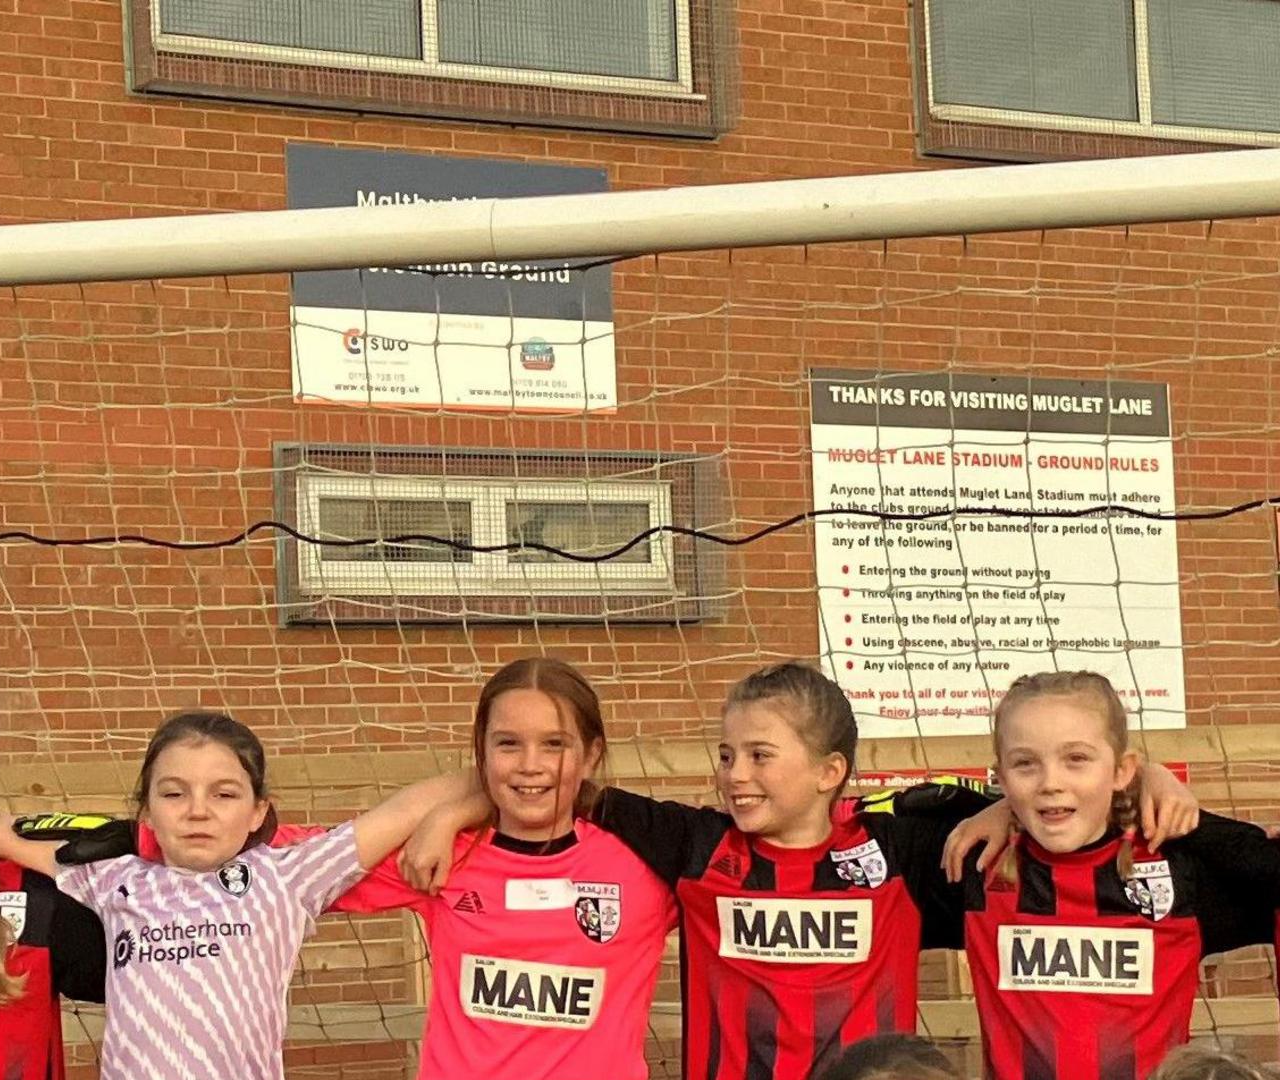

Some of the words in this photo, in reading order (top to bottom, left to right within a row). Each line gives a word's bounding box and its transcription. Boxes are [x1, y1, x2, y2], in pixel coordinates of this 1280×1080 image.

[481, 261, 570, 284] Ground
[334, 384, 420, 395] www.cswo.org.uk
[829, 386, 906, 406] THANKS
[910, 389, 947, 408] FOR
[950, 391, 1029, 411] VISITING
[1032, 395, 1104, 414] MUGLET
[1109, 398, 1153, 416] LANE
[829, 448, 898, 464] MUGLET
[903, 450, 946, 466] LANE
[951, 451, 1023, 468] STADIUM
[1037, 455, 1104, 470] GROUND
[1109, 457, 1160, 472] RULES
[829, 483, 875, 498] Anyone
[881, 485, 905, 497] that
[909, 485, 955, 498] attends
[959, 487, 1000, 501] Muglet
[1004, 489, 1032, 500] Lane
[1036, 489, 1085, 501] Stadium
[1089, 491, 1116, 502] must
[1121, 492, 1161, 503] adhere
[871, 502, 905, 514] clubs
[831, 519, 844, 530] to
[847, 519, 880, 531] leave
[883, 520, 902, 531] the
[905, 521, 952, 534] ground,
[955, 524, 967, 533] or
[969, 522, 984, 533] be
[987, 522, 1030, 533] banned
[1032, 522, 1050, 533] for
[1051, 525, 1059, 533] a
[1062, 523, 1098, 536] period
[1115, 524, 1145, 537] time,
[1147, 525, 1162, 536] for
[831, 538, 854, 549] any
[858, 536, 870, 547] of
[874, 537, 895, 547] the
[897, 537, 953, 550] following
[859, 565, 906, 578] Enterng
[909, 565, 927, 577] the
[971, 567, 1012, 578] without
[915, 589, 962, 602] anything
[965, 591, 979, 600] on
[982, 590, 999, 600] the
[1002, 590, 1026, 600] field
[1043, 591, 1066, 602] play
[912, 613, 930, 624] the
[932, 613, 957, 624] field
[959, 613, 971, 624] of
[974, 613, 996, 627] play
[999, 615, 1011, 624] at
[1013, 617, 1033, 627] any
[862, 637, 895, 650] Using
[897, 638, 948, 649] obscene,
[950, 638, 996, 649] abusve,
[998, 638, 1029, 647] racial
[1032, 639, 1043, 647] or
[863, 660, 885, 672] Any
[887, 660, 934, 671] violence
[937, 660, 949, 670] of
[952, 662, 972, 672] any
[975, 661, 1010, 671] nature
[879, 690, 901, 701] you
[918, 688, 931, 698] all
[935, 688, 946, 698] of
[950, 690, 968, 698] our
[139, 918, 252, 943] Rotherham
[732, 908, 858, 950] MANE
[138, 941, 221, 965] Hospice
[1011, 937, 1140, 980] MANE
[471, 966, 595, 1017] MANE
